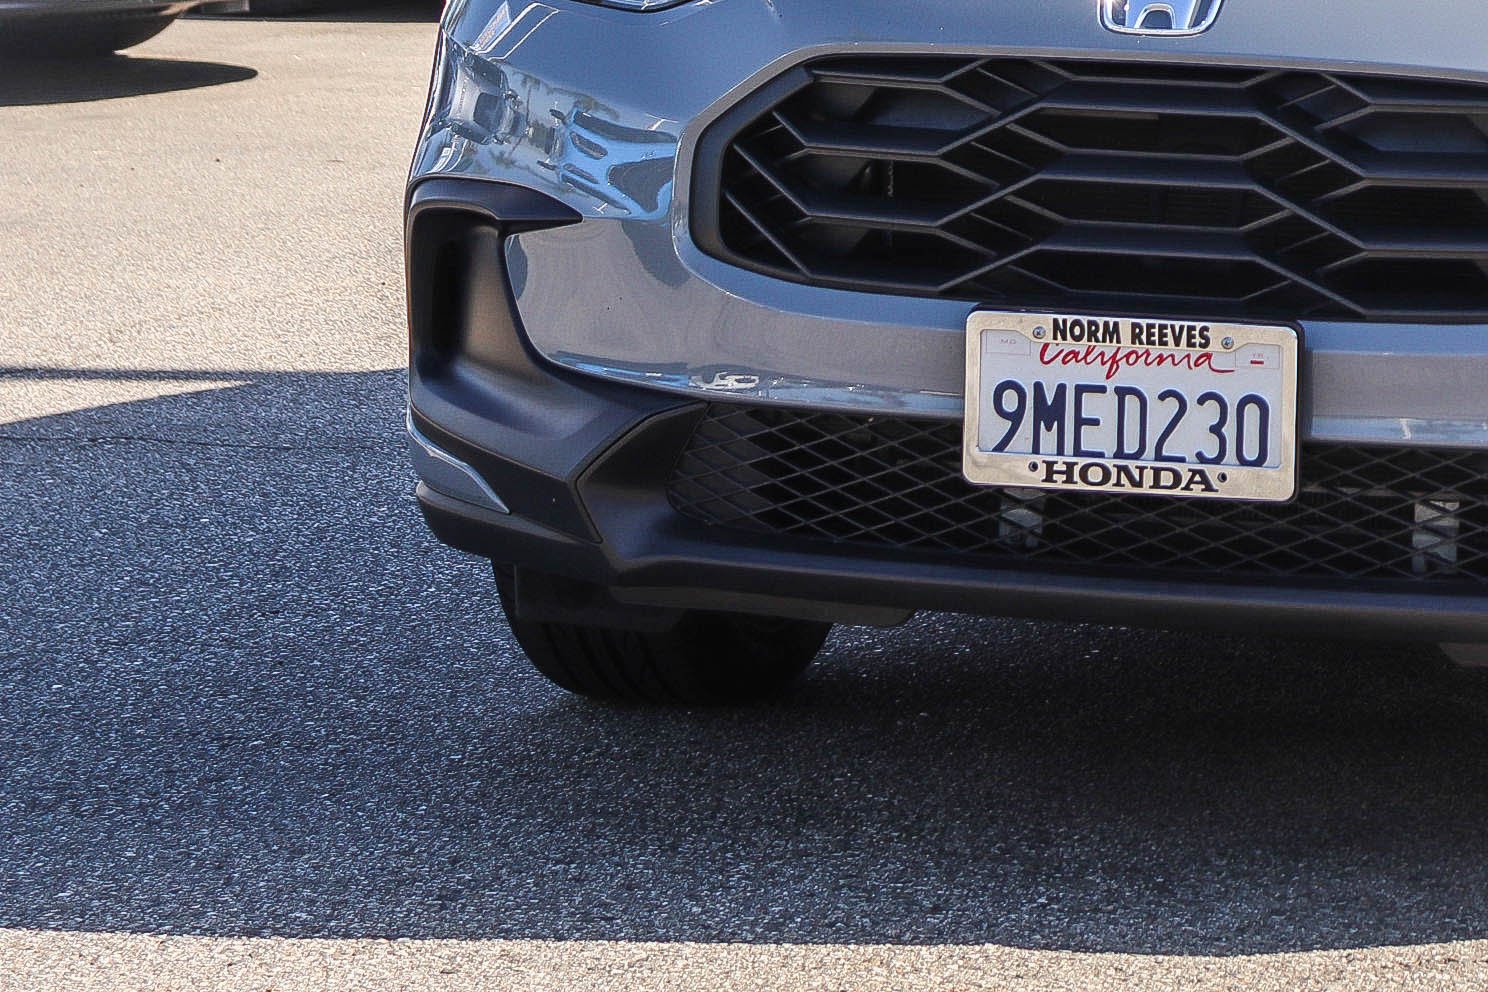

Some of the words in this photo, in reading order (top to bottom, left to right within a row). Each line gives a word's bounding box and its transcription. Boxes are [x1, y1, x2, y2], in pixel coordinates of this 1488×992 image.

[1052, 317, 1121, 344] NORM
[1130, 322, 1211, 349] REEVES
[1039, 342, 1235, 380] California
[991, 379, 1271, 468] 9MED230
[1041, 460, 1219, 493] HONDA
